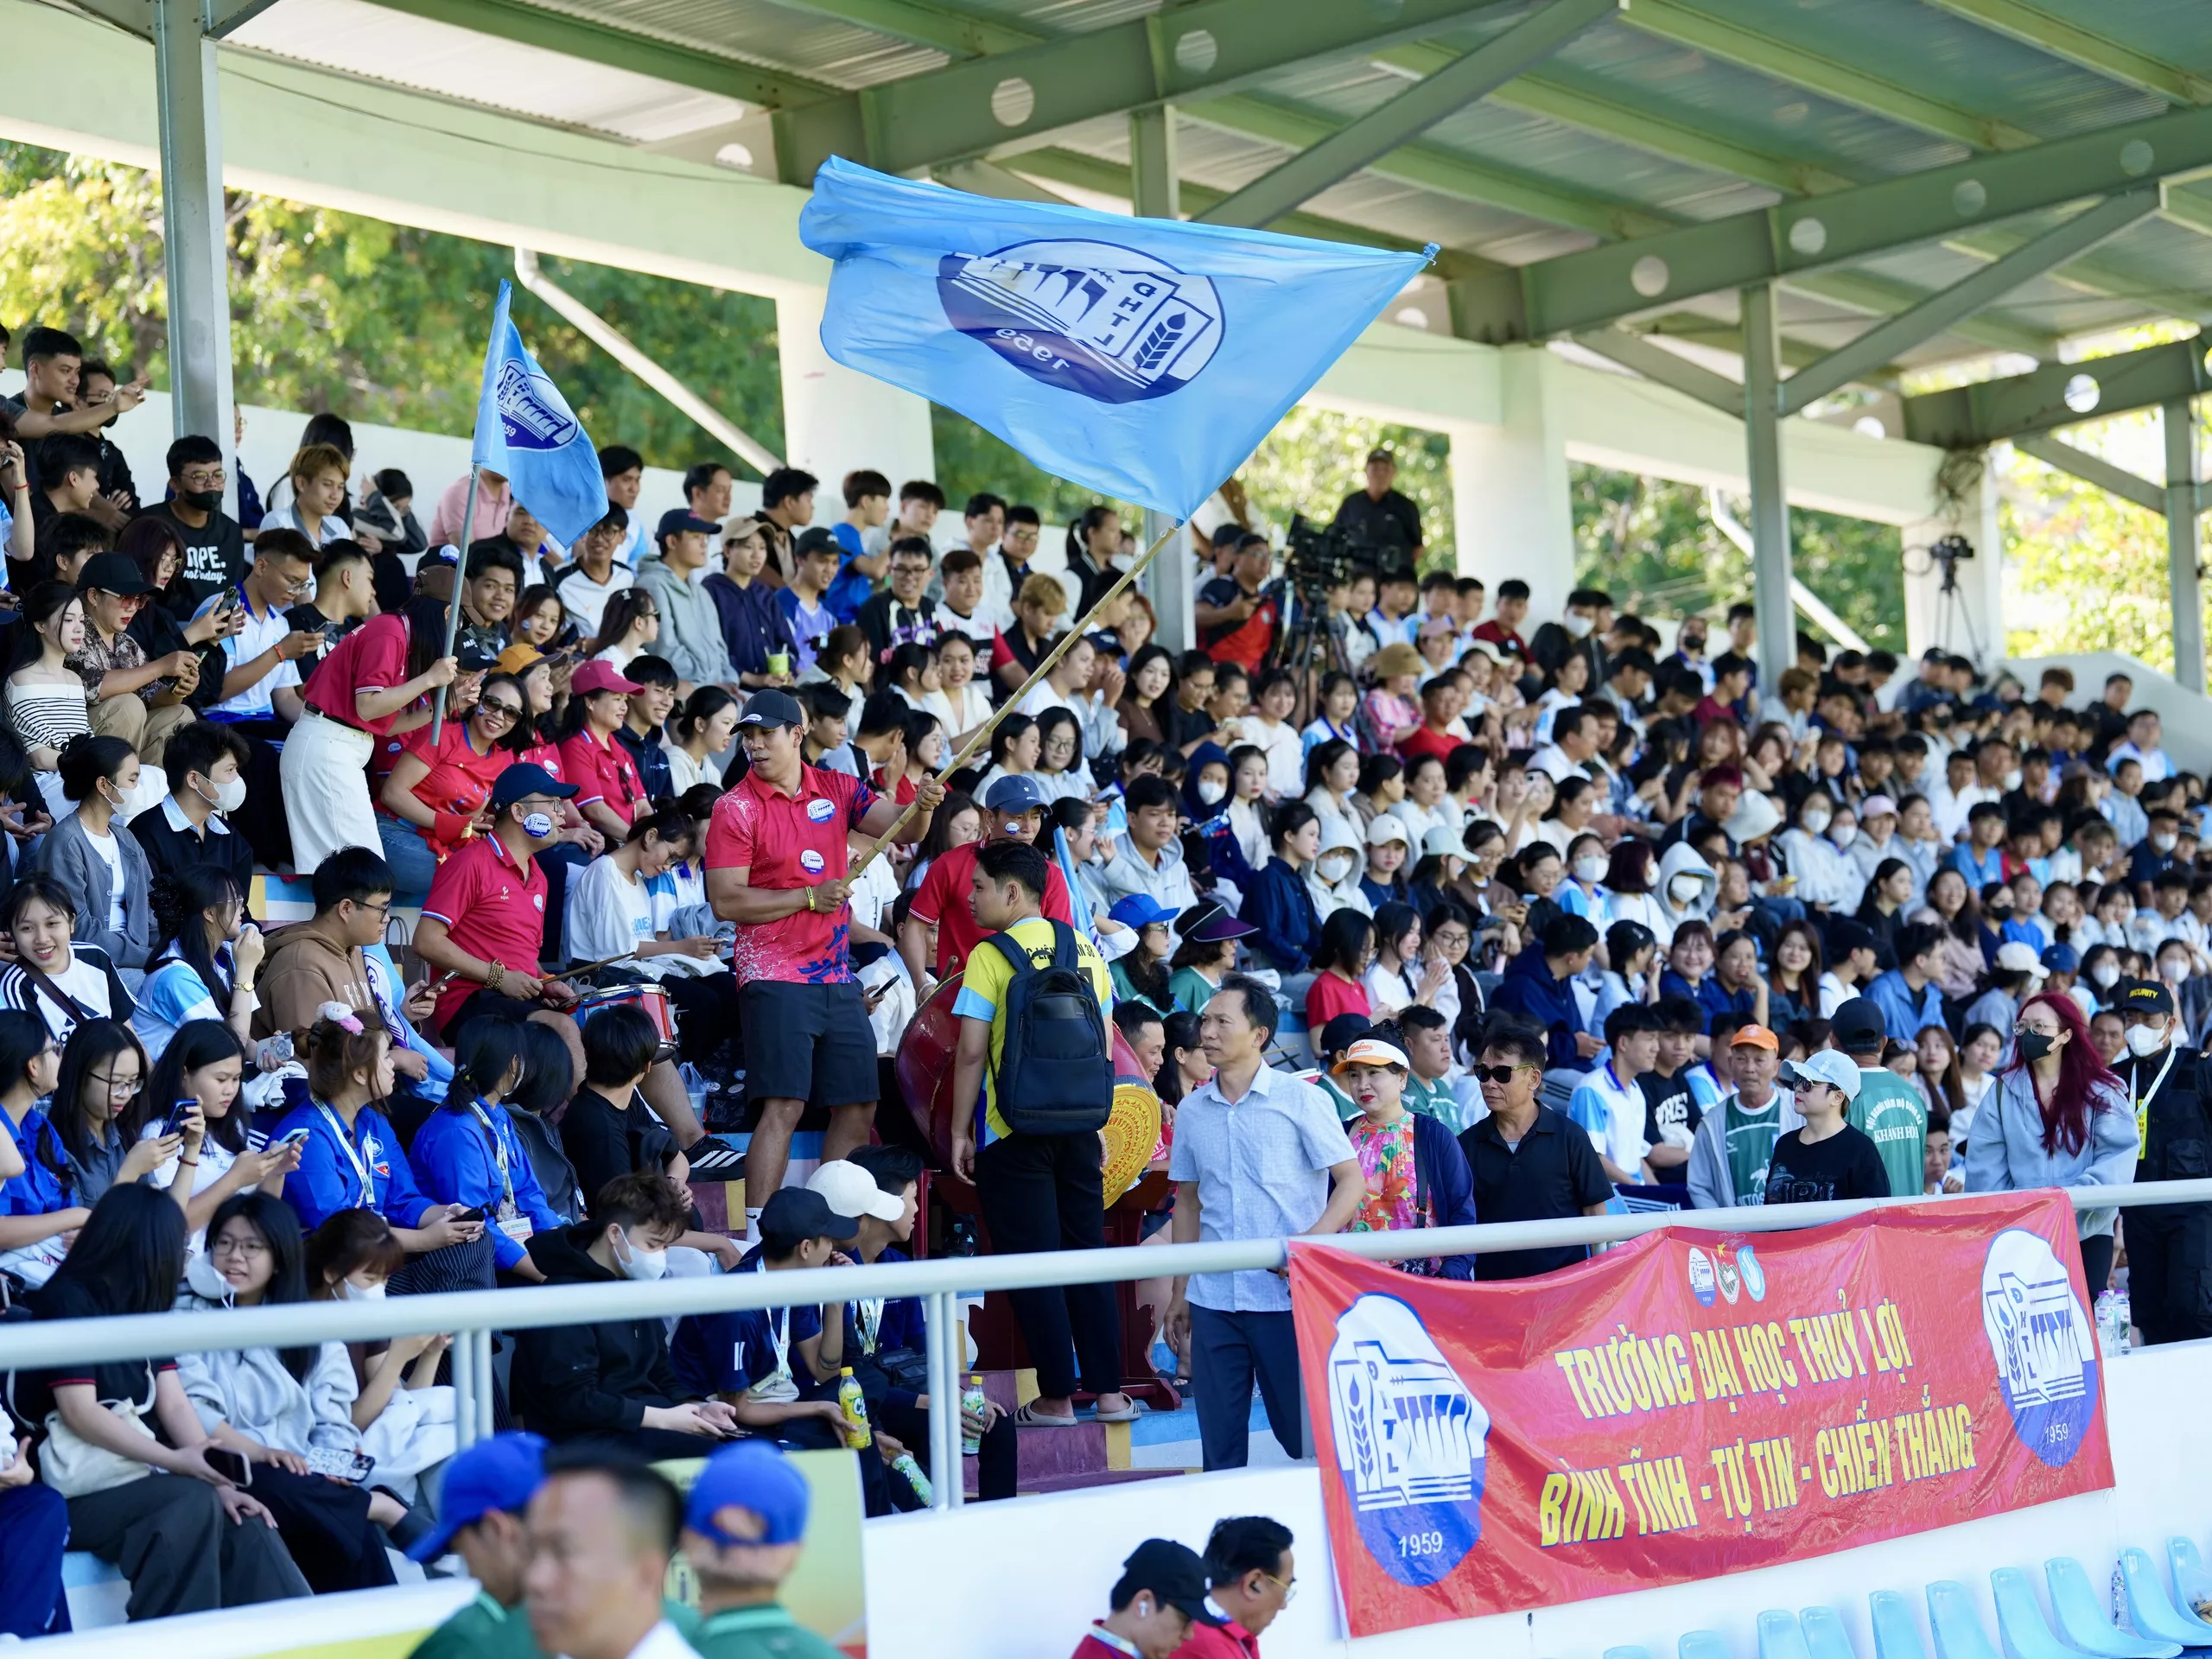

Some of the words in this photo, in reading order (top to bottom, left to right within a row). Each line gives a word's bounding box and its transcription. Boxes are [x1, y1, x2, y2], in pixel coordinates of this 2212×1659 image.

[2129, 988, 2158, 1000] SECURITY
[1873, 1124, 1905, 1143] KHÁNH
[1554, 1323, 1696, 1420] TRƯỜNG
[1690, 1328, 1745, 1414] ĐẠI
[1732, 1320, 1799, 1406] HỌC
[1788, 1287, 1868, 1384] THUỶ
[1859, 1296, 1914, 1384] LỢI
[2044, 1423, 2069, 1445] 1959
[1540, 1457, 1625, 1548] BÌNH
[1618, 1446, 1699, 1536] TĨNH
[1711, 1435, 1752, 1534] TỰ
[1748, 1435, 1798, 1513] TIN
[1816, 1398, 1893, 1499] CHIẾN
[1894, 1383, 1978, 1483] THẮNG
[1398, 1530, 1443, 1558] 1959
